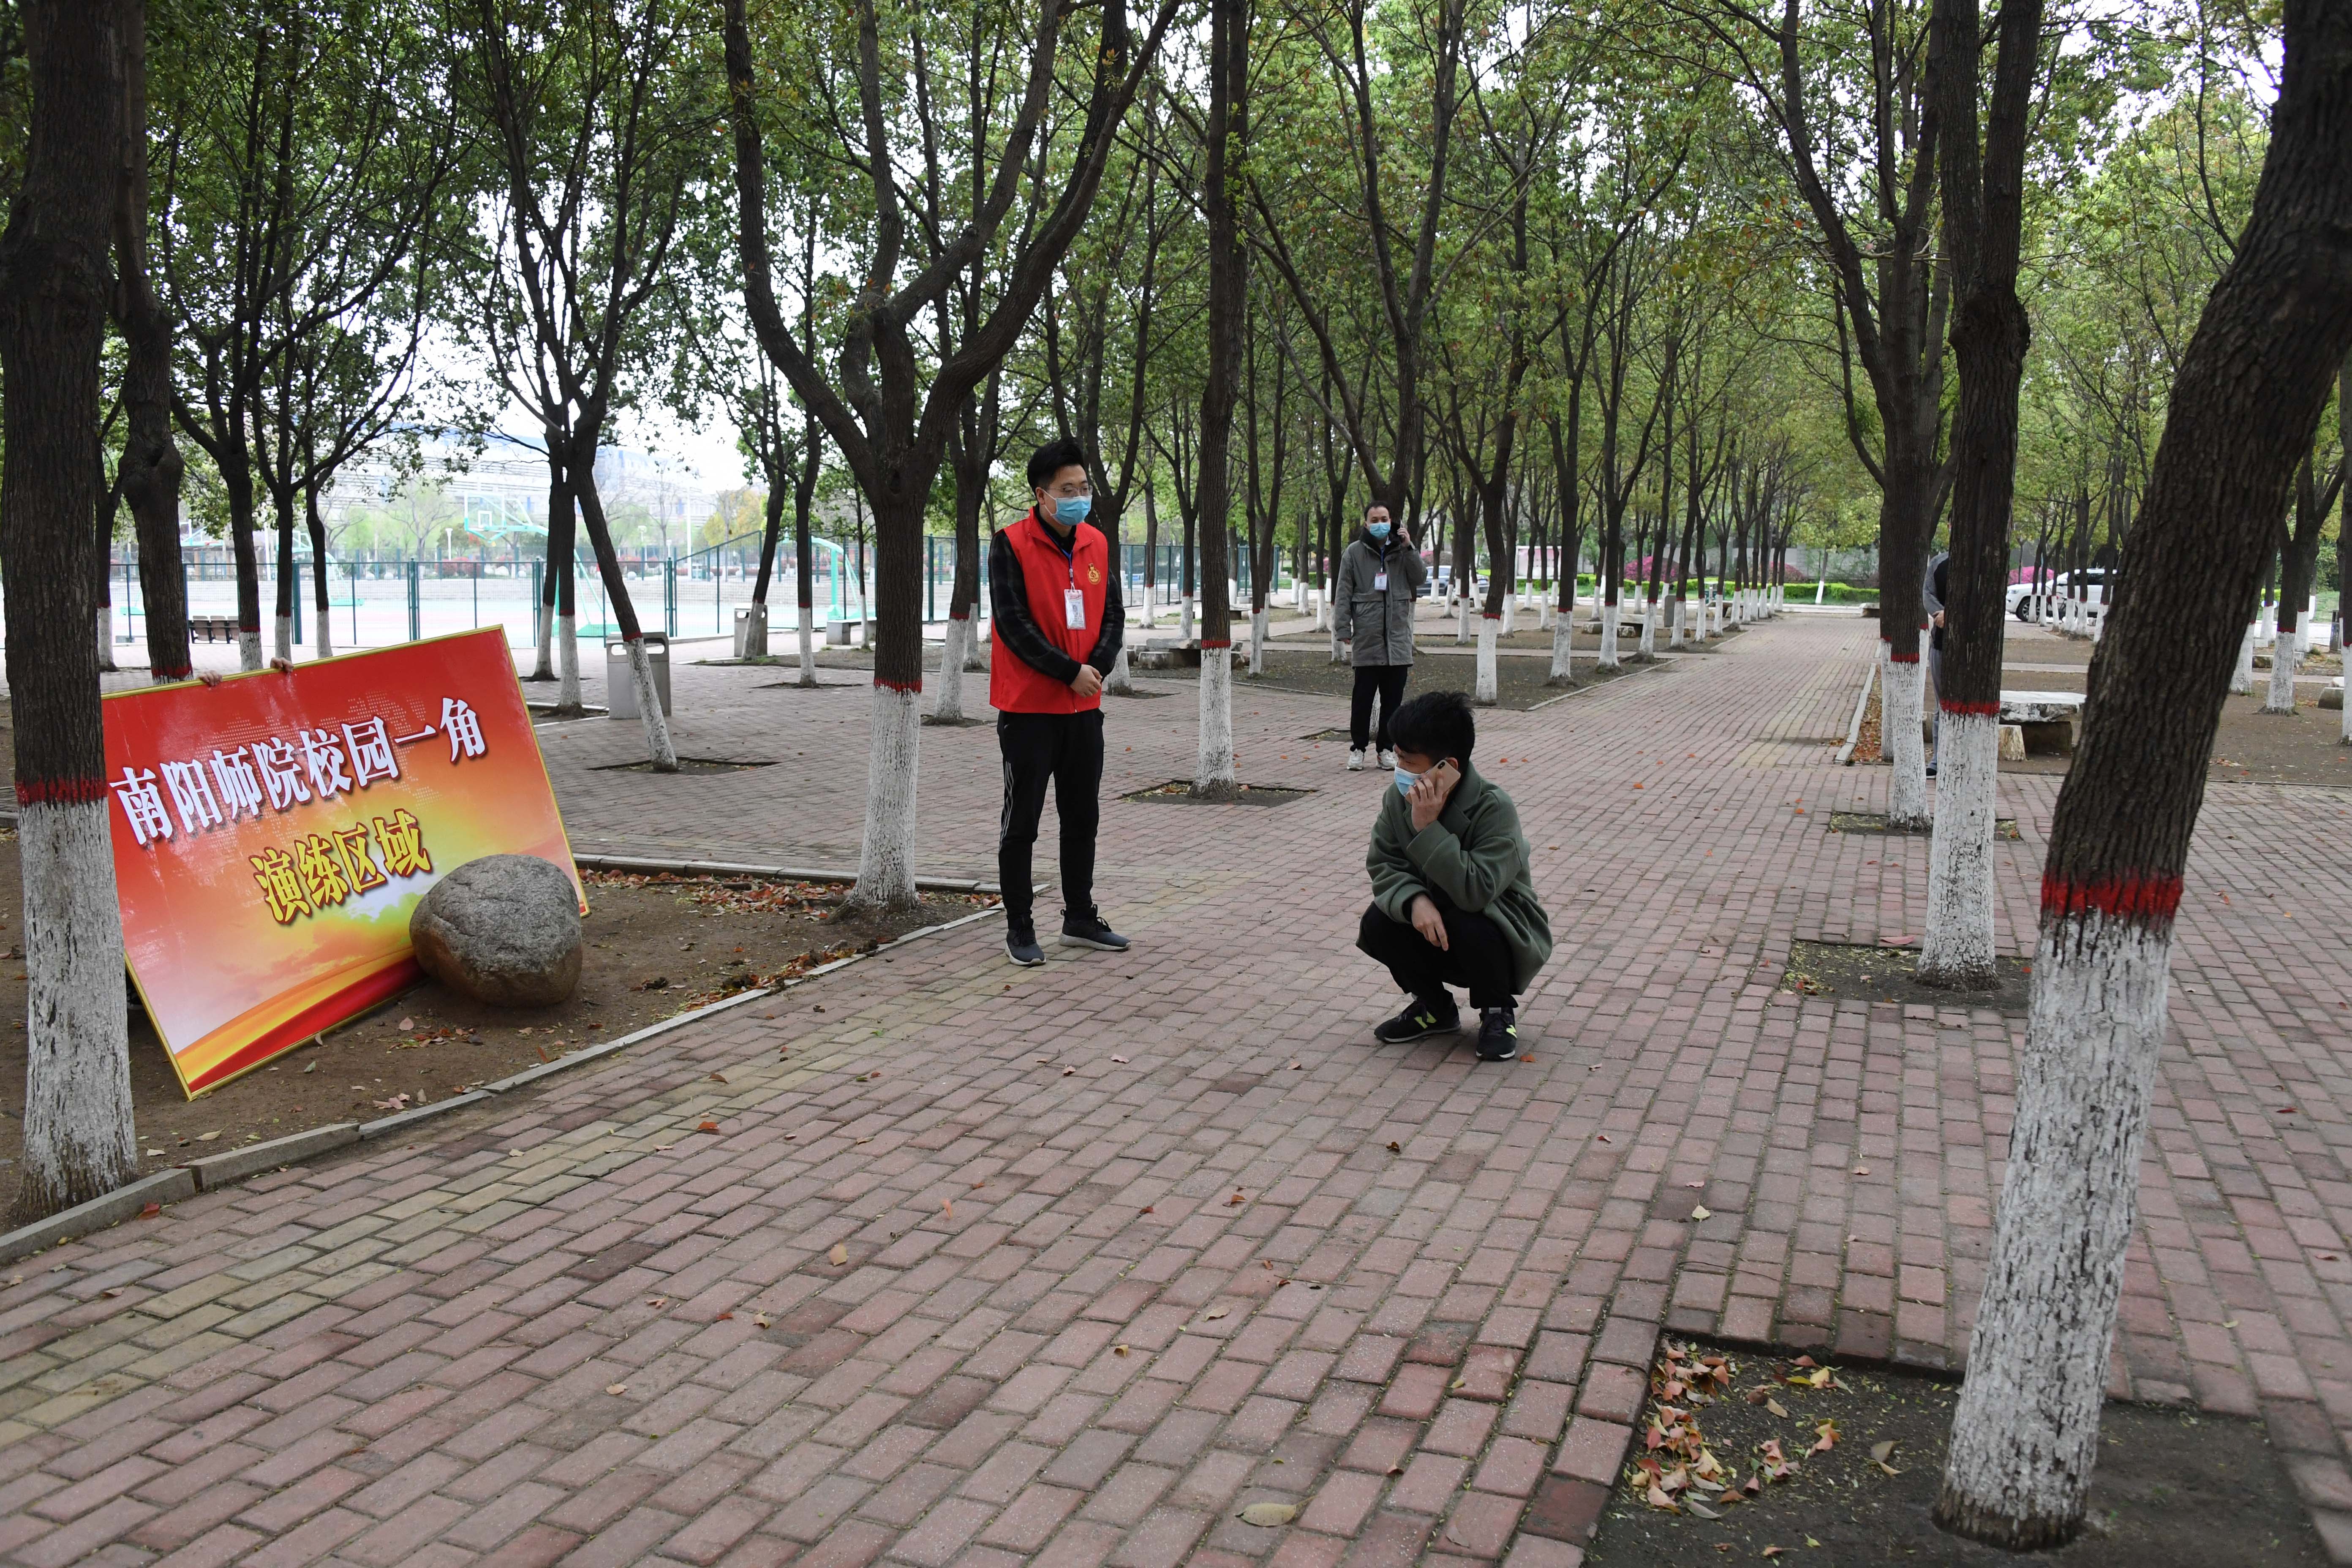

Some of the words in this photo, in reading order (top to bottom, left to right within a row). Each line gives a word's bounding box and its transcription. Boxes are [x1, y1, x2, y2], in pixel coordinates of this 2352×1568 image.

[109, 697, 487, 844] 南阳师院校园一角
[251, 810, 430, 922] 演练区域
